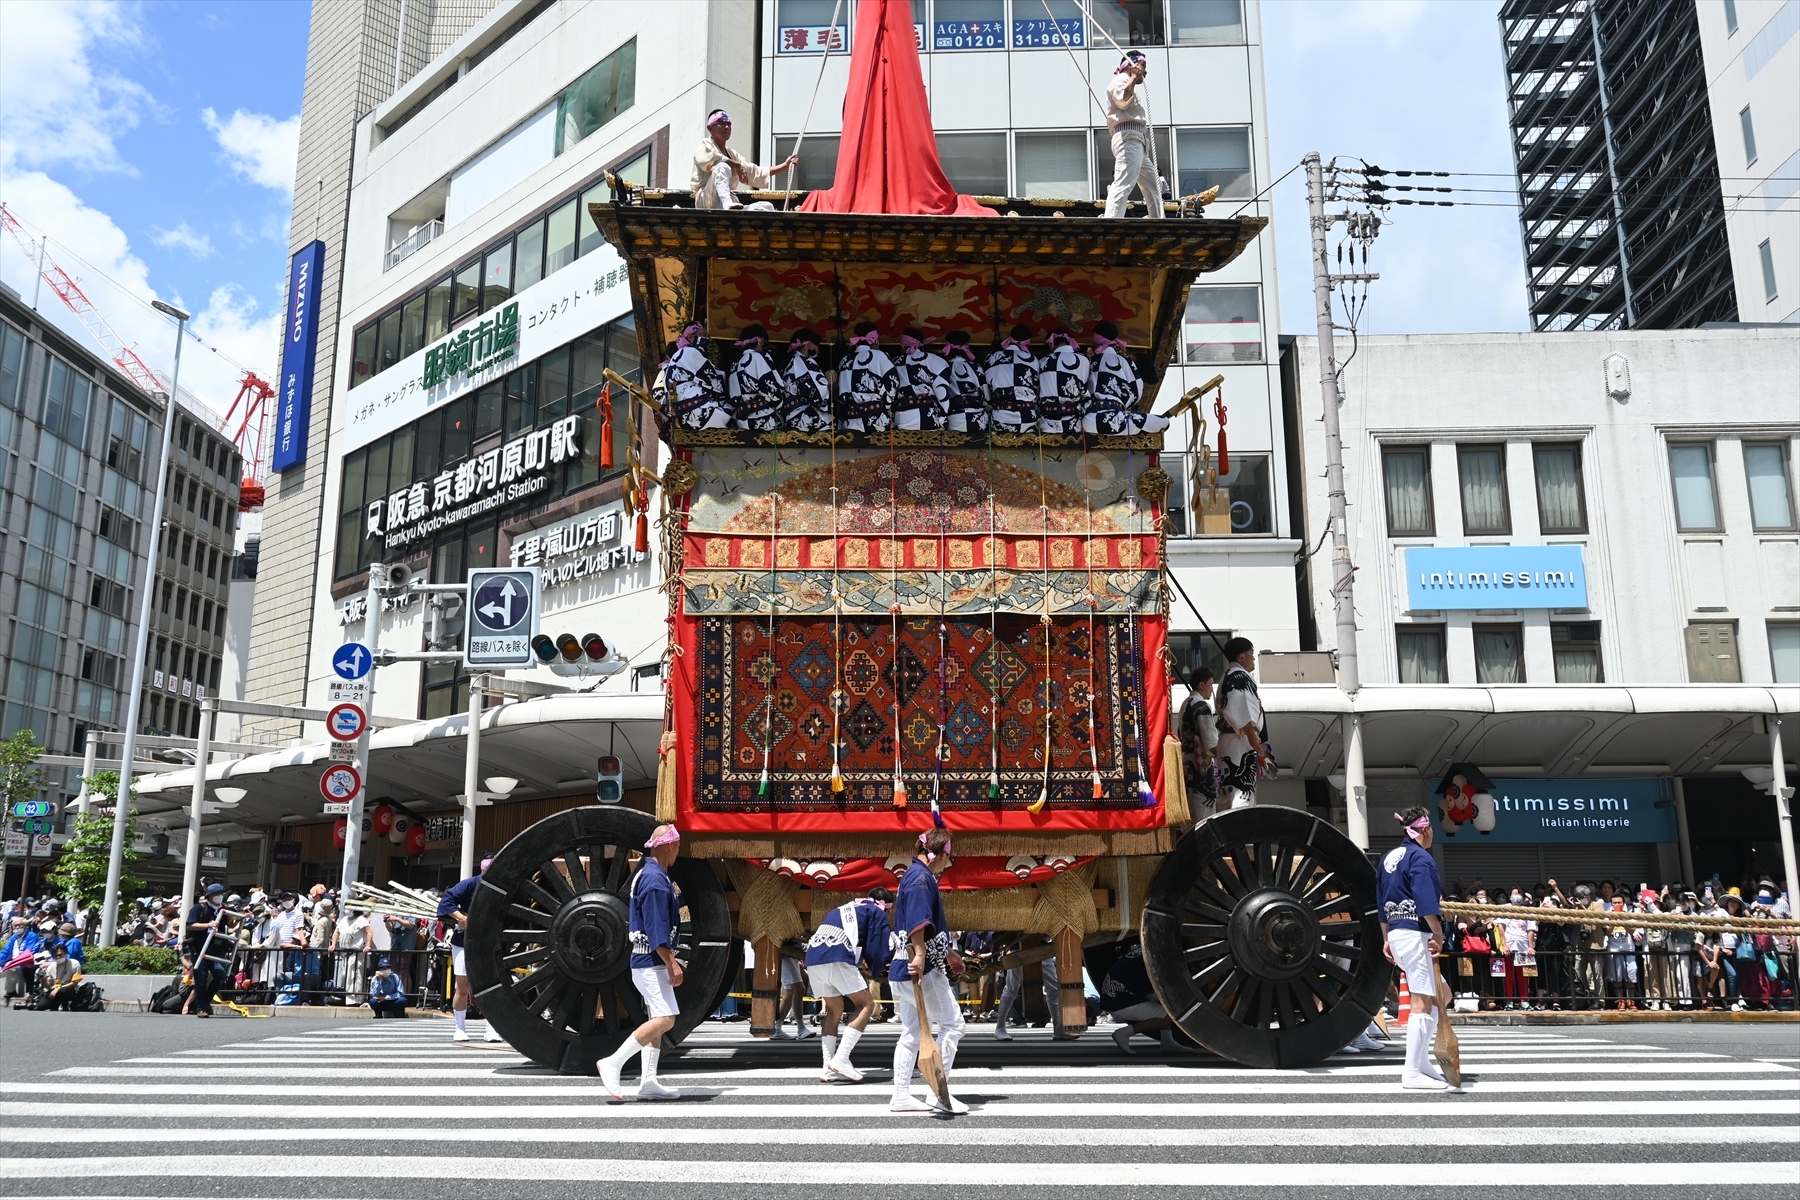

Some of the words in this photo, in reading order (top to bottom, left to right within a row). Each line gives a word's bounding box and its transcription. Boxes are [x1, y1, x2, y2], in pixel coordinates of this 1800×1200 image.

[784, 27, 842, 50] 薄毛
[293, 261, 309, 343] MIZUHO
[423, 301, 519, 391] 眼鏡市場
[281, 373, 296, 453] みずほ銀行
[353, 376, 423, 425] メガネ・サングラス
[385, 526, 417, 550] Hankyu
[417, 487, 505, 535] Kyoto-kawaramachi
[507, 477, 547, 501] Station
[509, 510, 620, 567] 千里・嵐山方面
[1421, 569, 1574, 586] intimissimi
[471, 640, 528, 653] 路線バスを除く
[330, 681, 369, 691] 路線バスを除く
[26, 804, 36, 814] 32
[1541, 817, 1580, 827] Italian
[1583, 816, 1630, 829] lingerie
